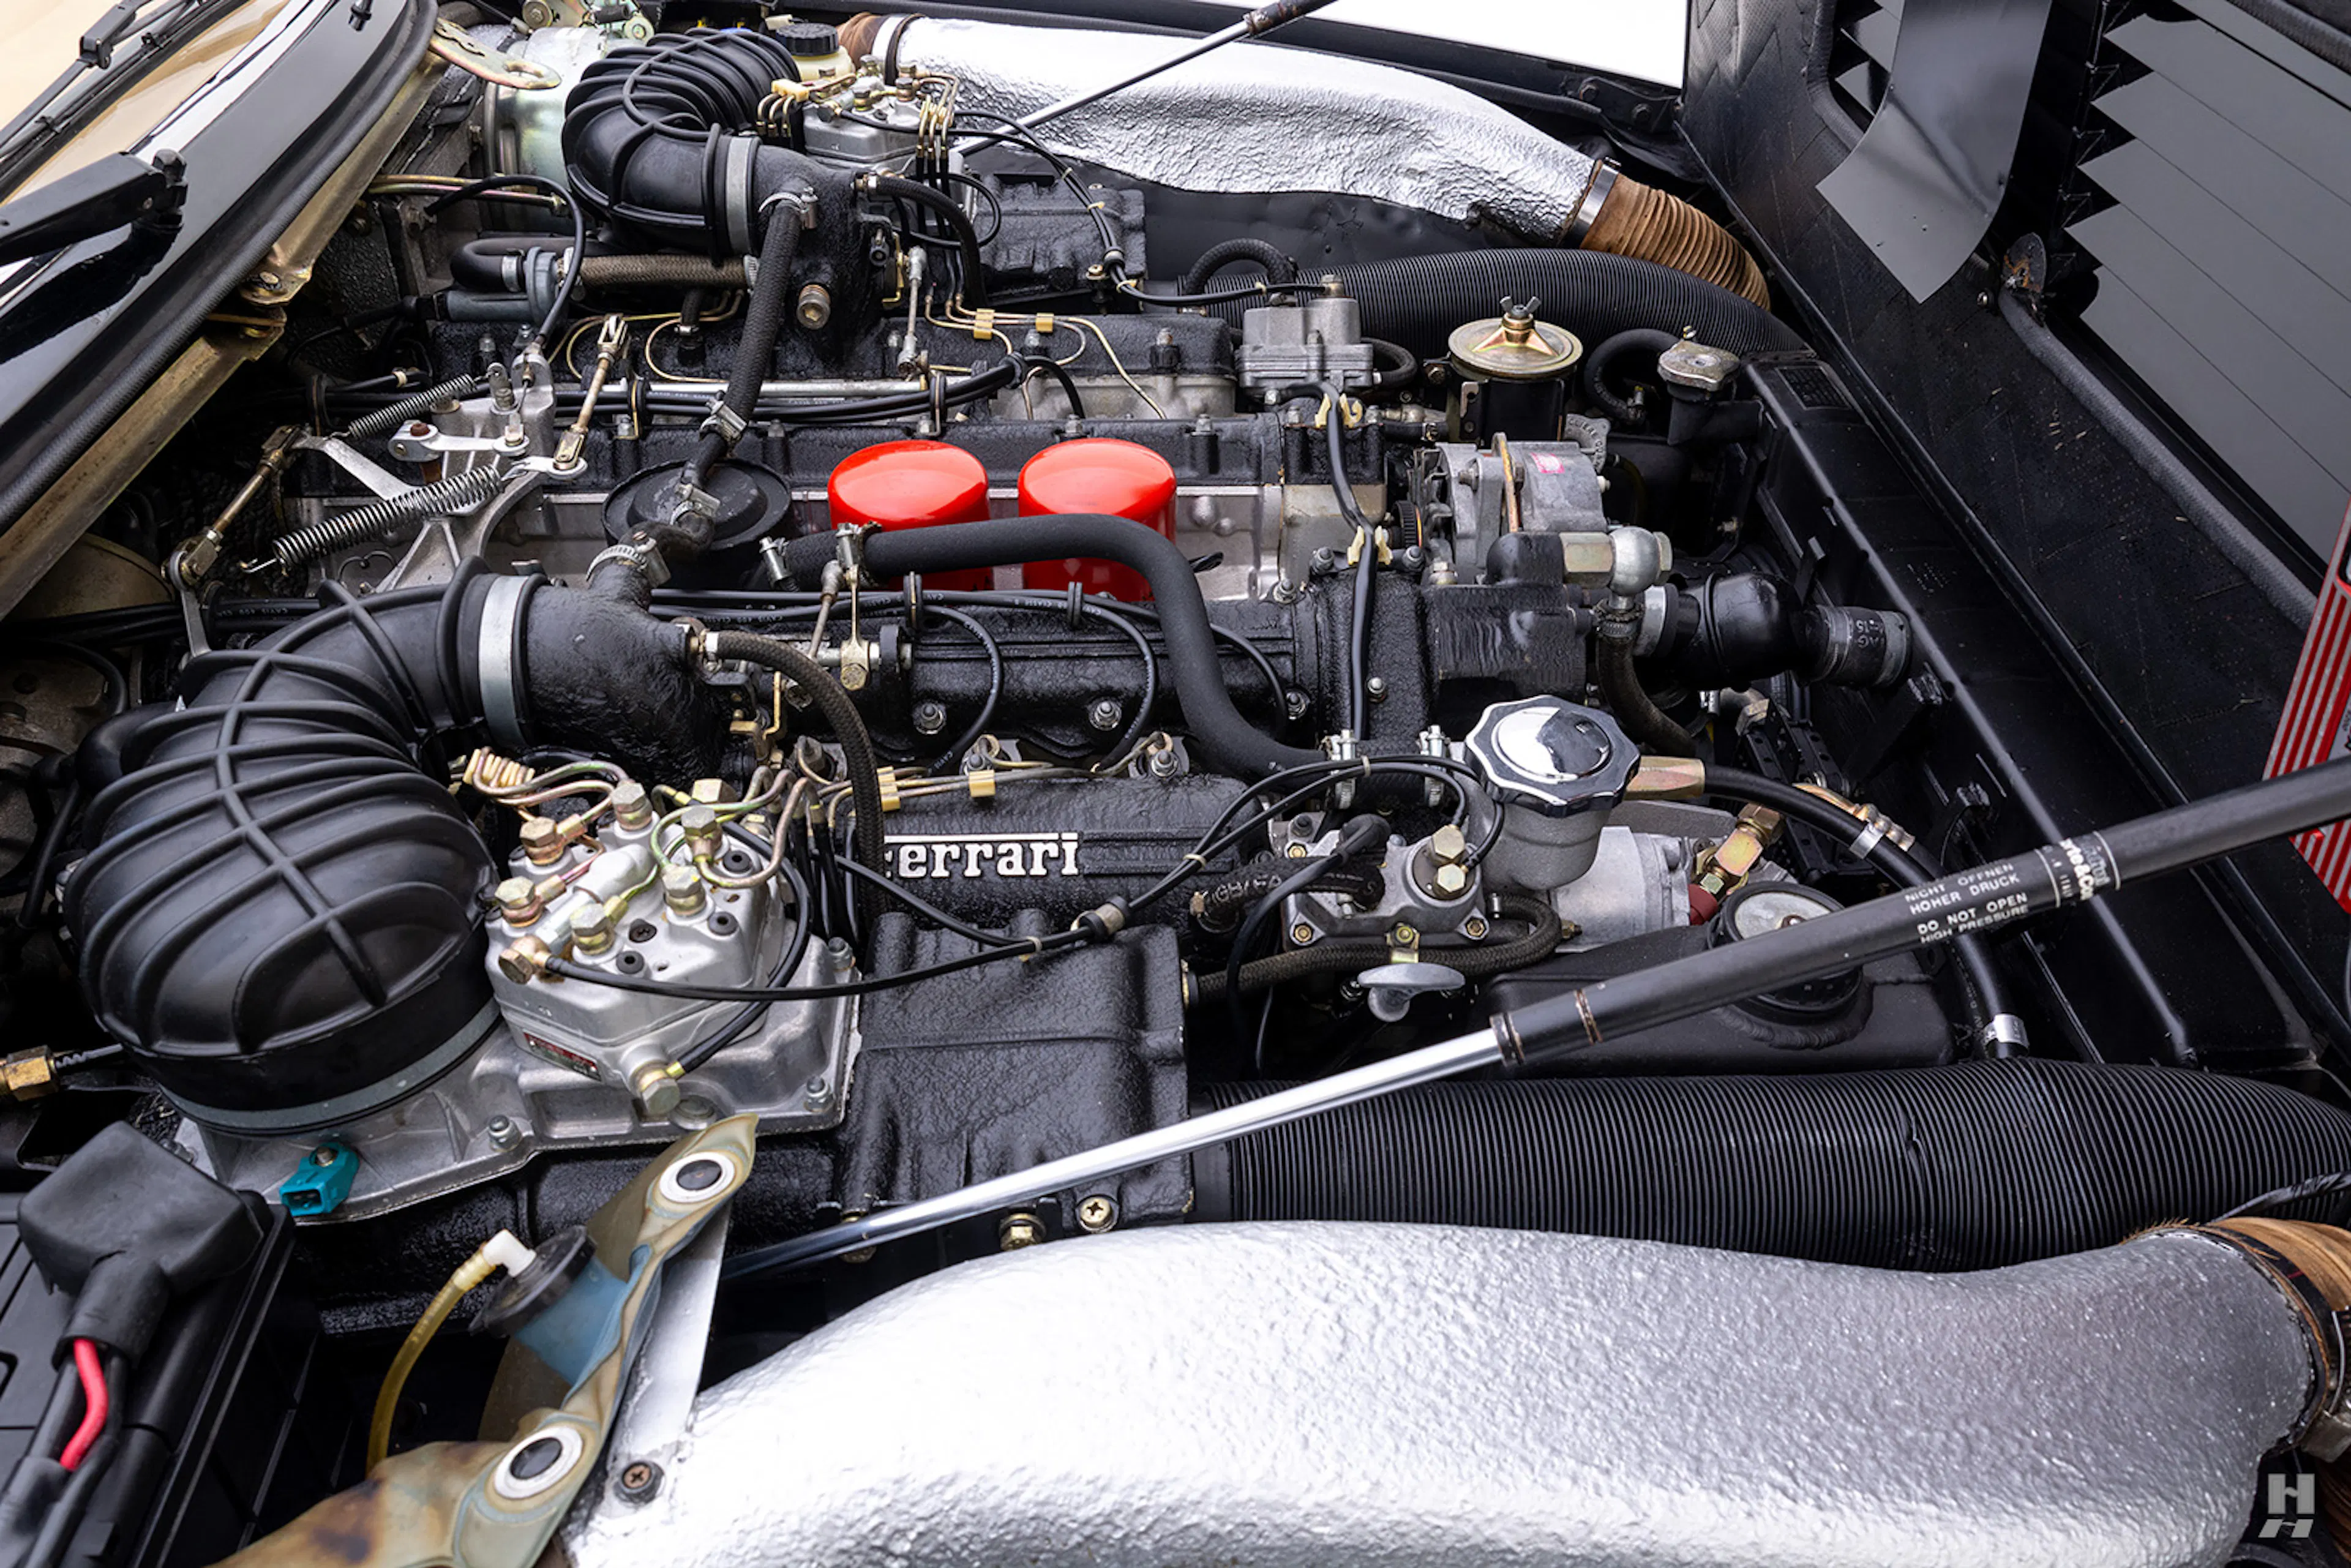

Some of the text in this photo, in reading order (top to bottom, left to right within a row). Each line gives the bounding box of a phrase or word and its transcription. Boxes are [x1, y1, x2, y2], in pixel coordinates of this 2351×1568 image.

[1905, 883, 1946, 902] NICHT
[1909, 872, 2020, 915] HOHER DRUCK
[1917, 891, 2028, 935] DO NOT OPEN
[1921, 904, 2029, 945] HIGH PRESSURE
